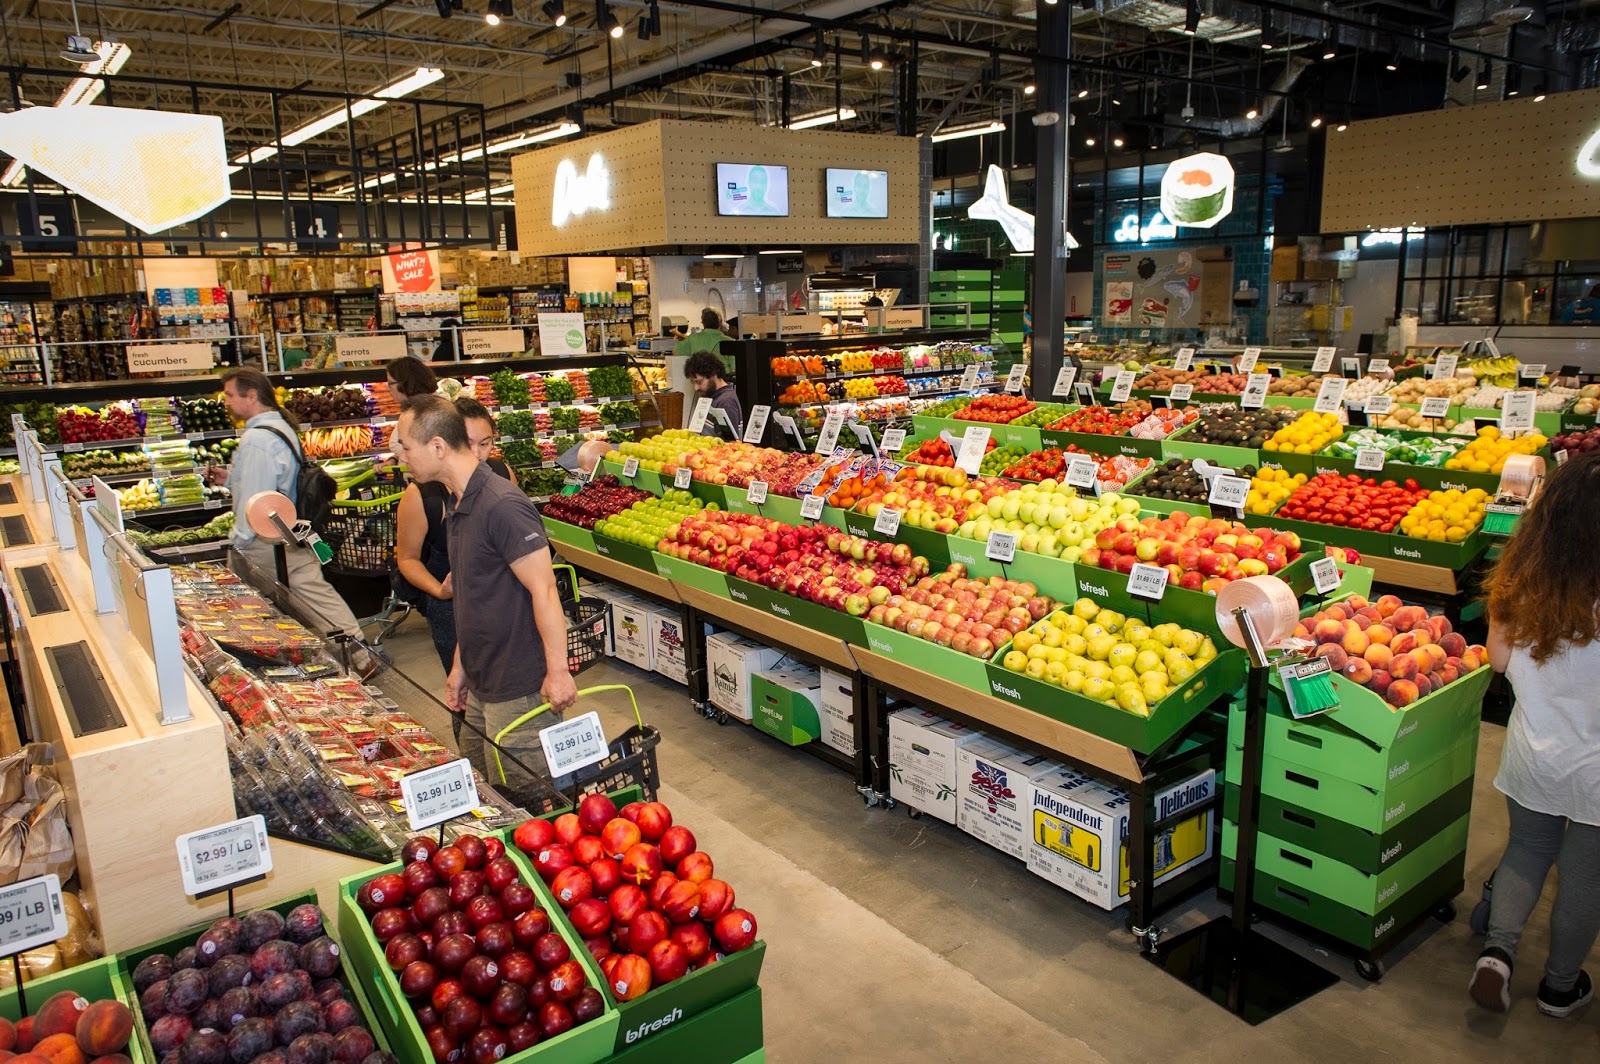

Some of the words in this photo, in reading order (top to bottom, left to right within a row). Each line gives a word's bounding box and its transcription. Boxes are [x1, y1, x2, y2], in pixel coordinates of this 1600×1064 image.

[38, 215, 59, 237] 5
[308, 217, 328, 239] 4
[396, 256, 426, 272] WHAT?!
[401, 268, 425, 280] SALE
[341, 348, 370, 356] carrots
[466, 342, 491, 351] greens
[133, 356, 188, 367] cucumbers
[1120, 446, 1138, 454] bfresh
[1440, 481, 1468, 491] bfresh
[848, 524, 869, 538] bfresh
[951, 551, 976, 565] bfresh
[1393, 547, 1422, 558] bfresh
[1079, 580, 1109, 597] bfresh
[870, 637, 893, 653] bfresh
[991, 680, 1022, 700] bfresh
[554, 738, 576, 753] $2.99
[580, 731, 593, 743] LB
[1388, 760, 1410, 780] bfresh
[416, 787, 442, 803] $2.99
[448, 780, 462, 793] LB
[971, 771, 1016, 799] Sage
[1033, 789, 1104, 831] Independent
[1160, 781, 1209, 820] Delicious
[1385, 801, 1406, 821] bfresh
[195, 846, 227, 865] $2.99
[236, 839, 253, 852] LB
[1381, 841, 1402, 863] bfresh
[3, 889, 27, 899] PEACHES
[1377, 882, 1399, 903] bfresh
[25, 901, 45, 917] LB
[1374, 916, 1395, 938] bfresh
[625, 1007, 683, 1044] bfresh
